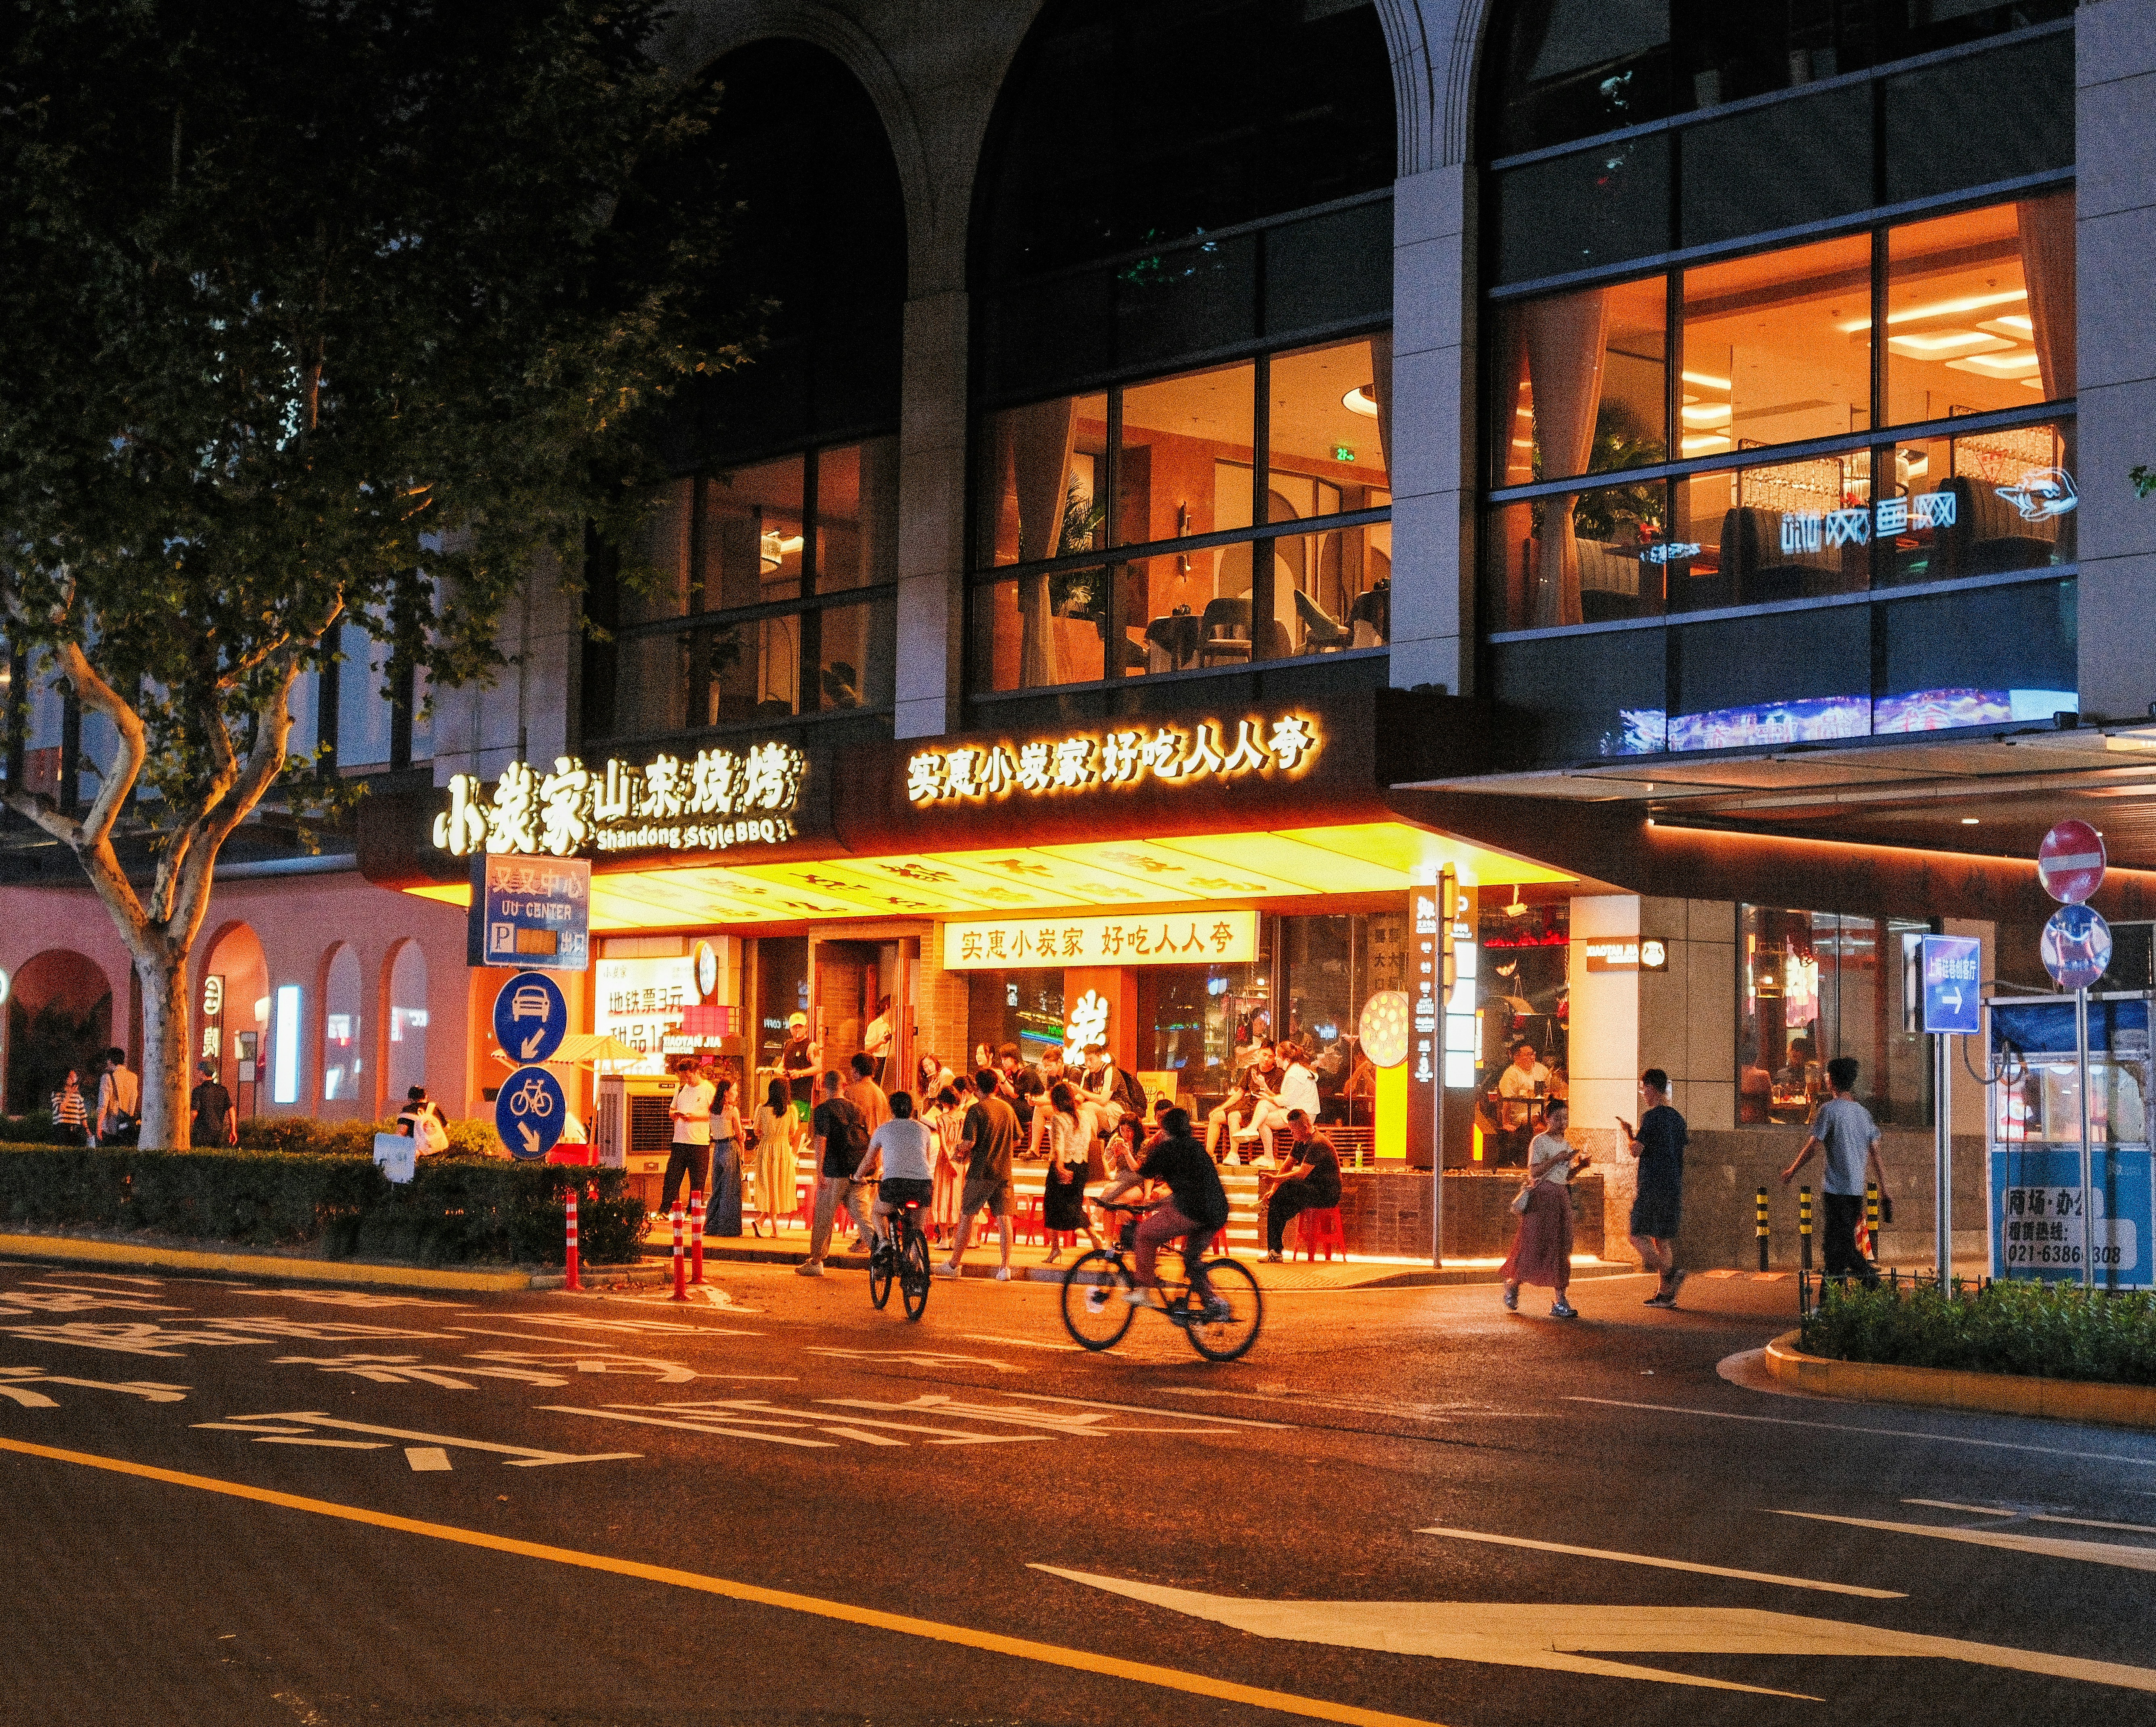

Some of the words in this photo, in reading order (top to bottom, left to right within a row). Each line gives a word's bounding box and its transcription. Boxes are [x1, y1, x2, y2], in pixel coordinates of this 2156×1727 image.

[908, 739, 1093, 802] 实惠小炭家
[1101, 715, 1310, 782] 好吃人人夸
[597, 826, 680, 850] Shandong
[688, 823, 733, 850] Style
[736, 820, 774, 843] BBQ
[502, 900, 519, 917] UU
[525, 902, 572, 920] CENTER
[495, 926, 510, 950] P
[560, 931, 584, 953] 出口
[961, 927, 1084, 961] 实惠小炭家
[1101, 921, 1234, 956] 好吃人人夸
[608, 985, 684, 1015] 地铁票3元
[663, 1035, 702, 1047] XIAOTAN
[703, 1036, 722, 1048] JIA
[2008, 1245, 2121, 1264] 021-6386308
